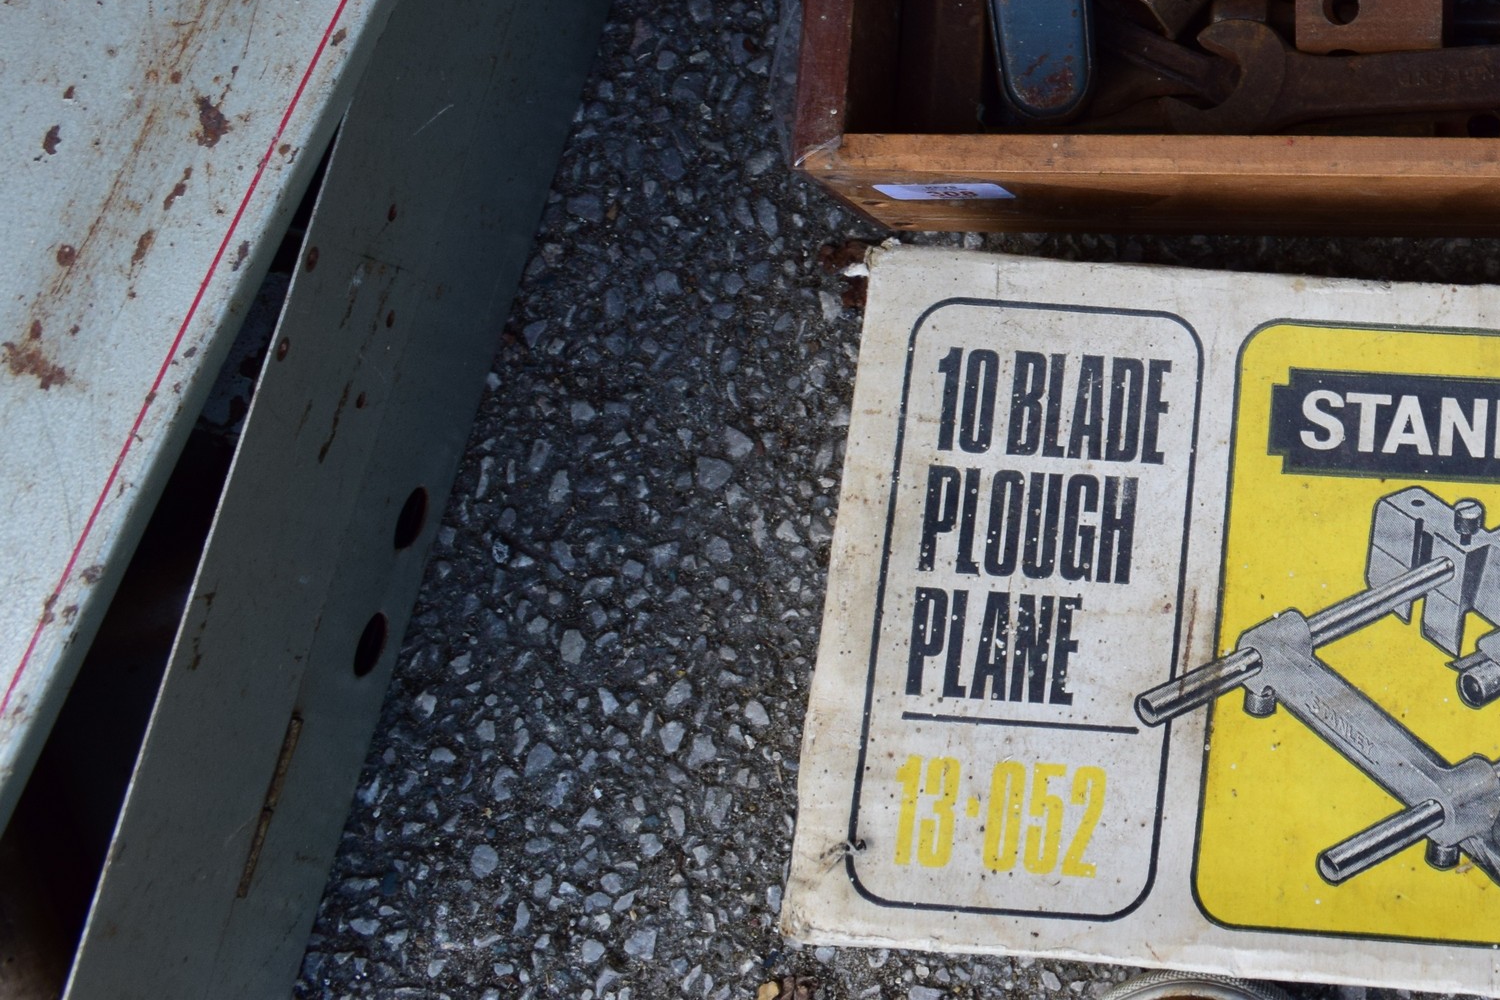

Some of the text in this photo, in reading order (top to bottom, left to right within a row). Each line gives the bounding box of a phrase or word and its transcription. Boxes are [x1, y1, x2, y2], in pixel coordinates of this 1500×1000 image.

[937, 347, 1172, 465] 10 BLADE
[918, 465, 1138, 584] PLOUGH
[905, 586, 1083, 707] PLANE
[1309, 696, 1375, 755] STANLEY
